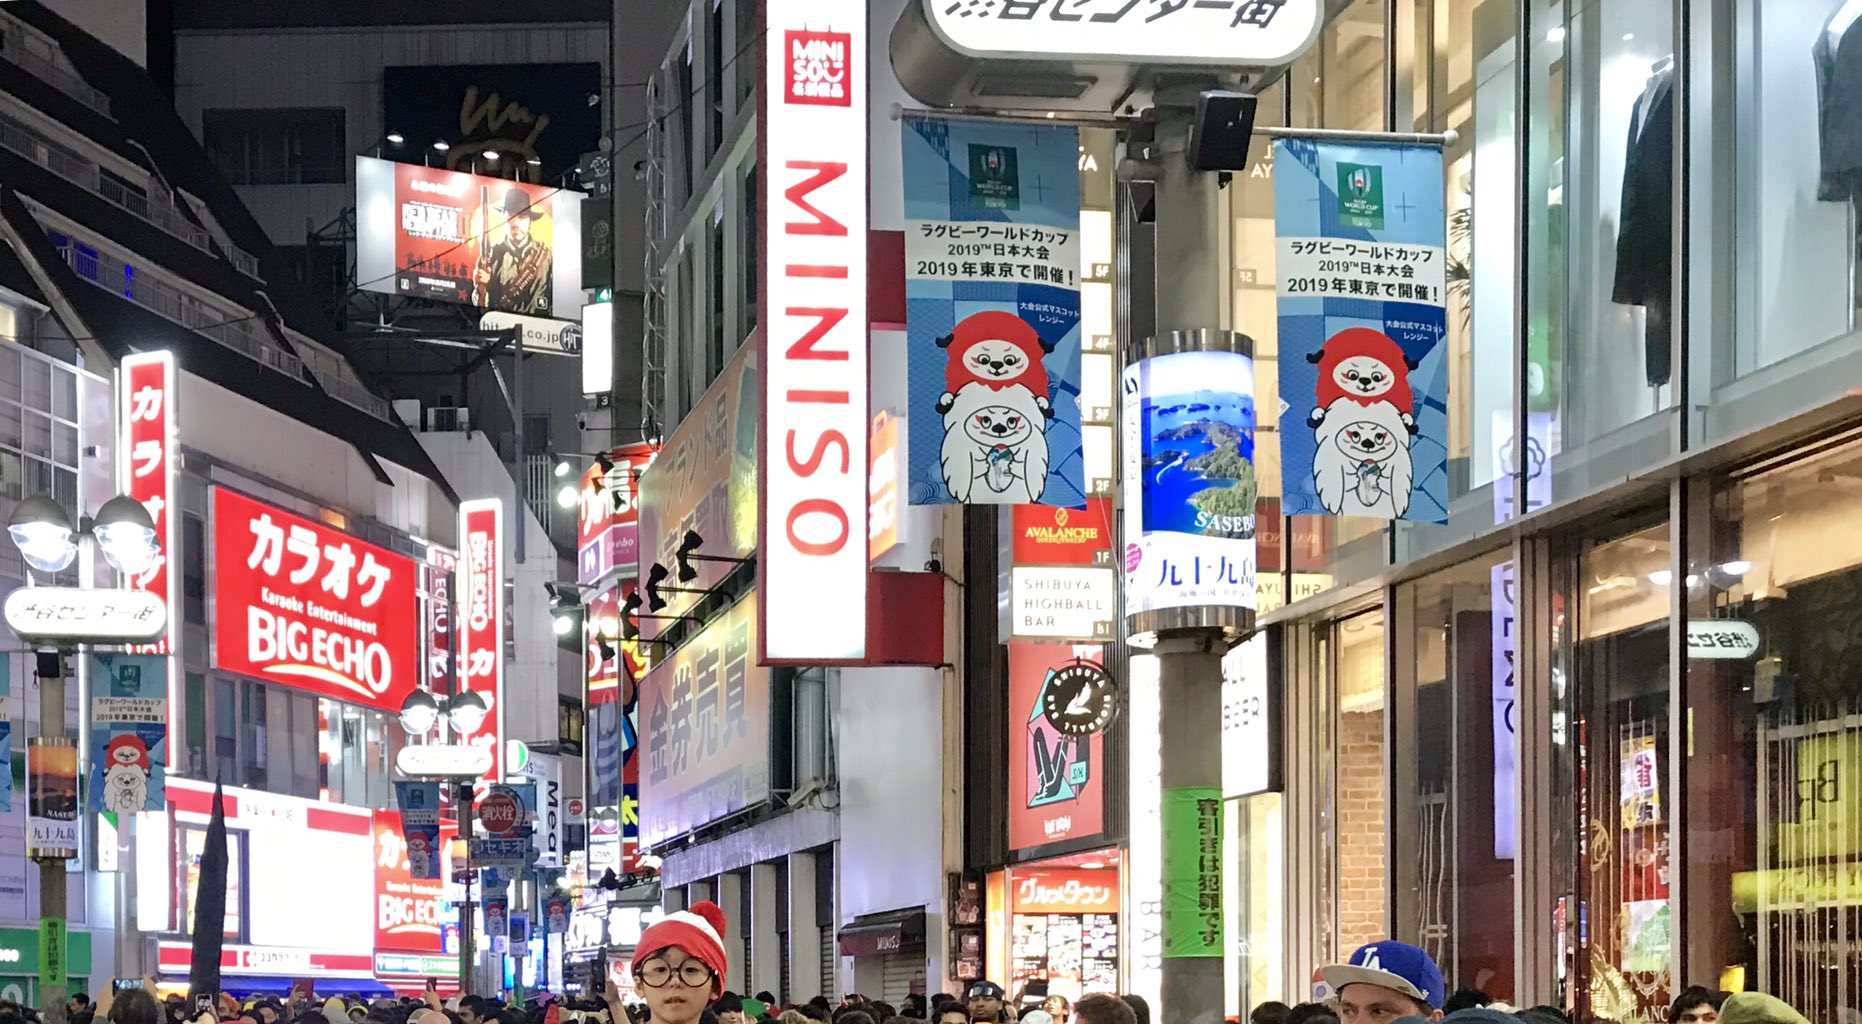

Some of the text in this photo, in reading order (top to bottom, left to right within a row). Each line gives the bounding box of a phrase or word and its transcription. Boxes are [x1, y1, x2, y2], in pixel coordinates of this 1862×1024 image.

[792, 39, 844, 61] MINI
[1344, 202, 1366, 210] WORLD
[920, 223, 1069, 246] ラグビーワールドカップ
[1290, 241, 1433, 262] ラグビーワールドカップ
[1095, 264, 1109, 277] 5F
[1038, 314, 1065, 325] レンジー
[1403, 331, 1429, 342] レンジー
[784, 160, 849, 556] MINISO
[1096, 479, 1110, 492] 2F
[1025, 527, 1098, 539] AVALANCHE
[247, 513, 391, 608] カラオケ
[1096, 551, 1110, 563] 1F
[1024, 579, 1091, 590] SHIBUYA
[261, 586, 377, 636] Karaoke Entertainment
[470, 573, 488, 632] ECHO
[1024, 598, 1103, 610] HIGHBALL
[1024, 616, 1055, 627] BAR
[248, 605, 392, 694] BIG ECHO
[1053, 667, 1106, 689] SHIBUYA
[1046, 694, 1060, 721] BAR
[1065, 694, 1112, 733] HIGHBALL
[482, 805, 514, 822] 消火栓
[1197, 798, 1220, 947] 客引きは犯罪です
[1019, 877, 1110, 905] グルメタウン
[379, 894, 415, 930] BIG
[1361, 946, 1388, 973] LA
